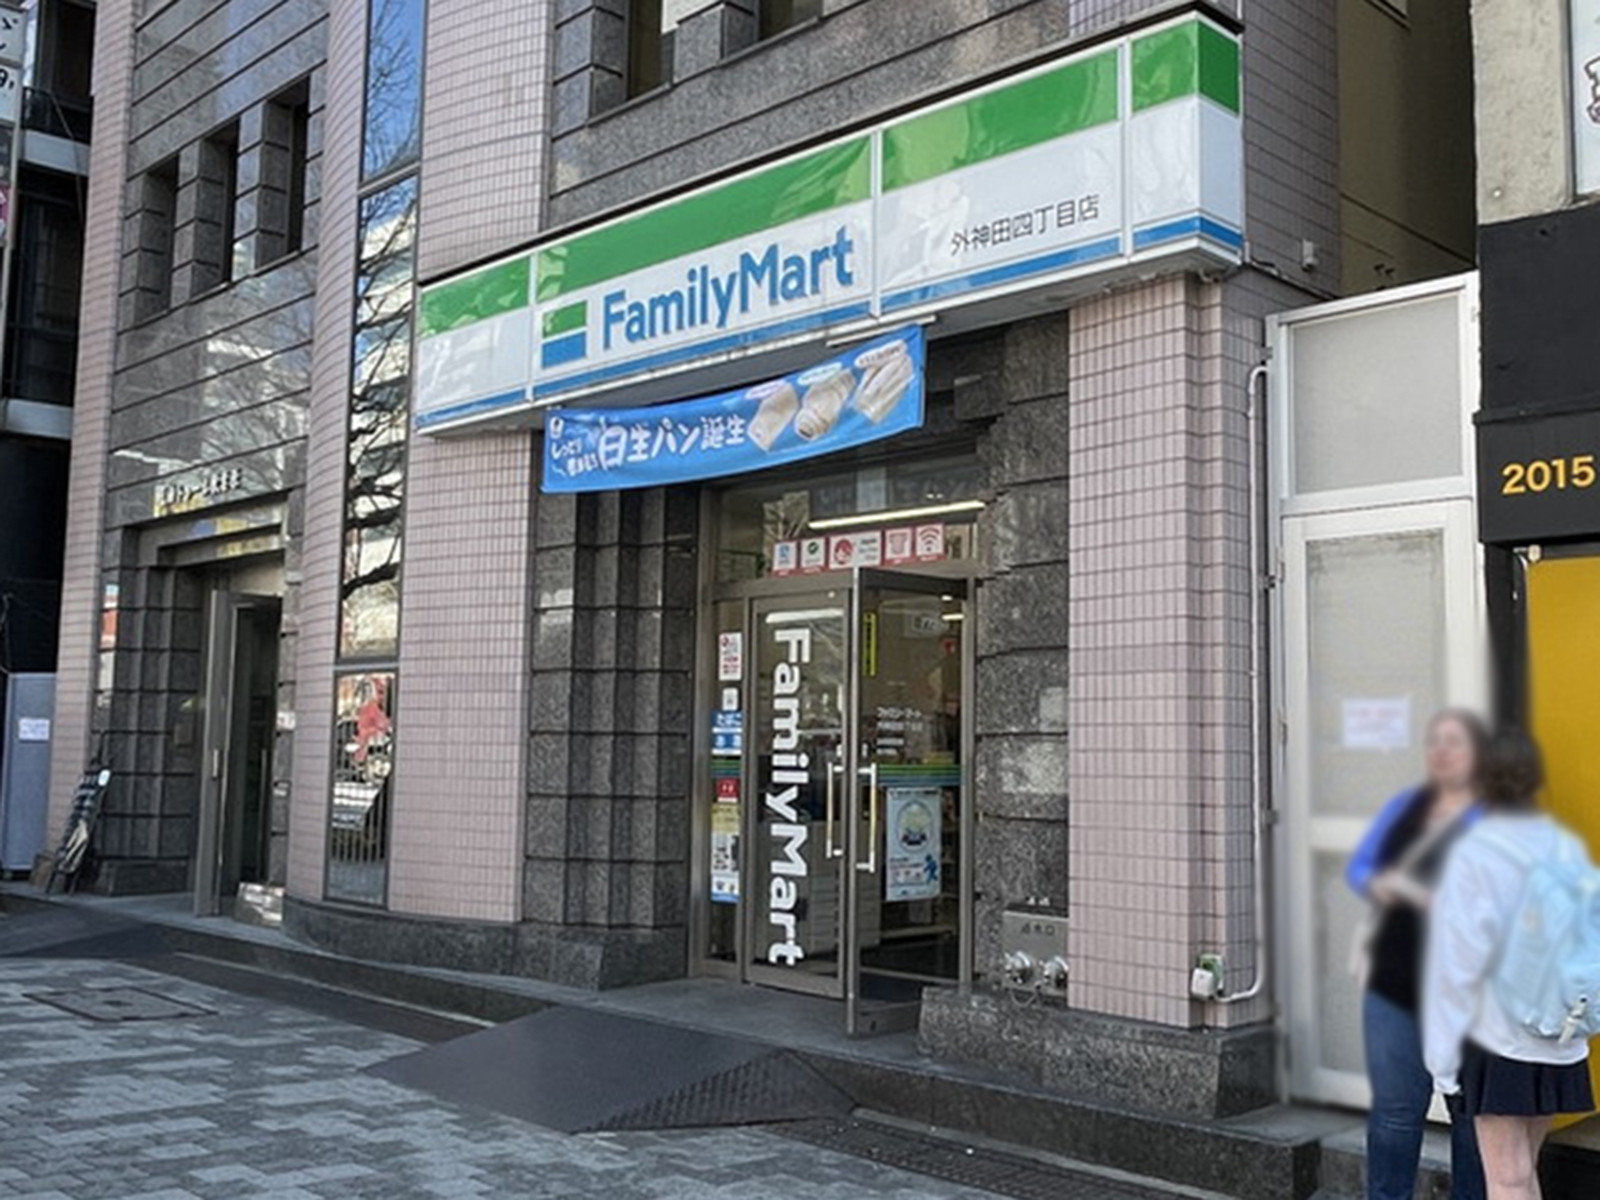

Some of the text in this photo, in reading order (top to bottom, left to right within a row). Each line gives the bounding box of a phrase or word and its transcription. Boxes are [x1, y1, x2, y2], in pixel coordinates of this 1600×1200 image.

[950, 194, 1100, 257] 外神田四丁目店
[603, 225, 854, 351] FamilyMart
[1501, 455, 1596, 495] 2015
[765, 628, 811, 967] FamilyMart
